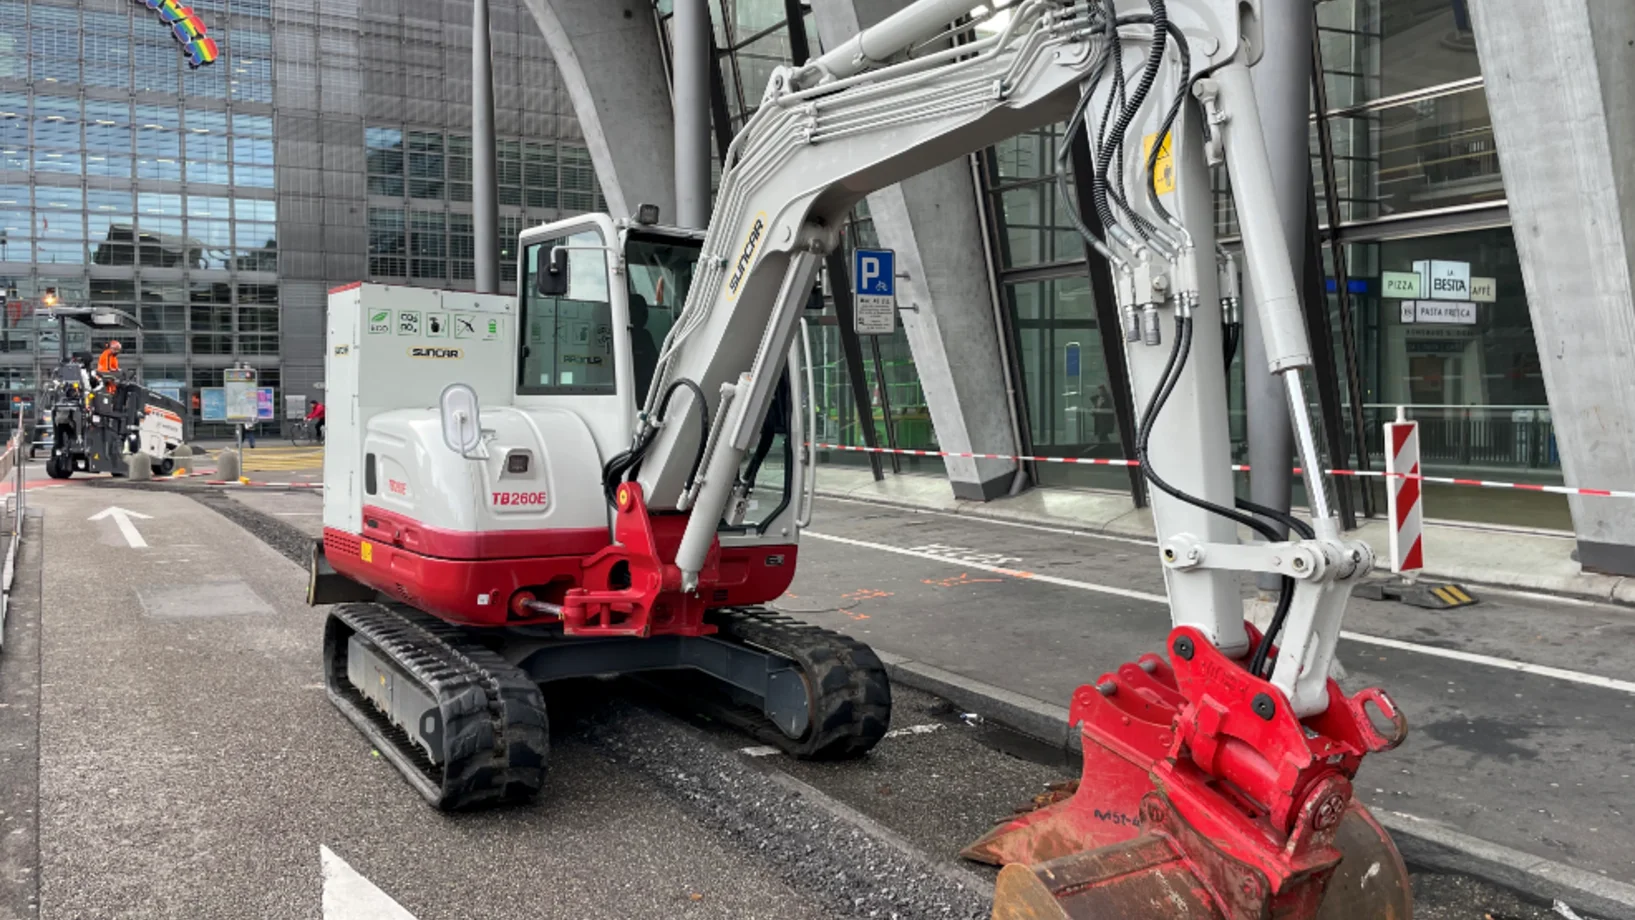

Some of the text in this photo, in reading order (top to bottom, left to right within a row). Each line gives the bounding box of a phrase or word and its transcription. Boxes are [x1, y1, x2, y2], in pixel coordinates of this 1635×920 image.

[728, 219, 764, 294] SUNCAR
[861, 256, 880, 290] P
[1446, 268, 1455, 277] LA
[1387, 280, 1413, 291] PIZZA
[1471, 284, 1491, 297] AFFÈ
[1420, 307, 1443, 317] PASTA
[1444, 308, 1471, 318] FRESCA
[412, 348, 459, 359] SUNCAR
[492, 492, 547, 506] TB260E
